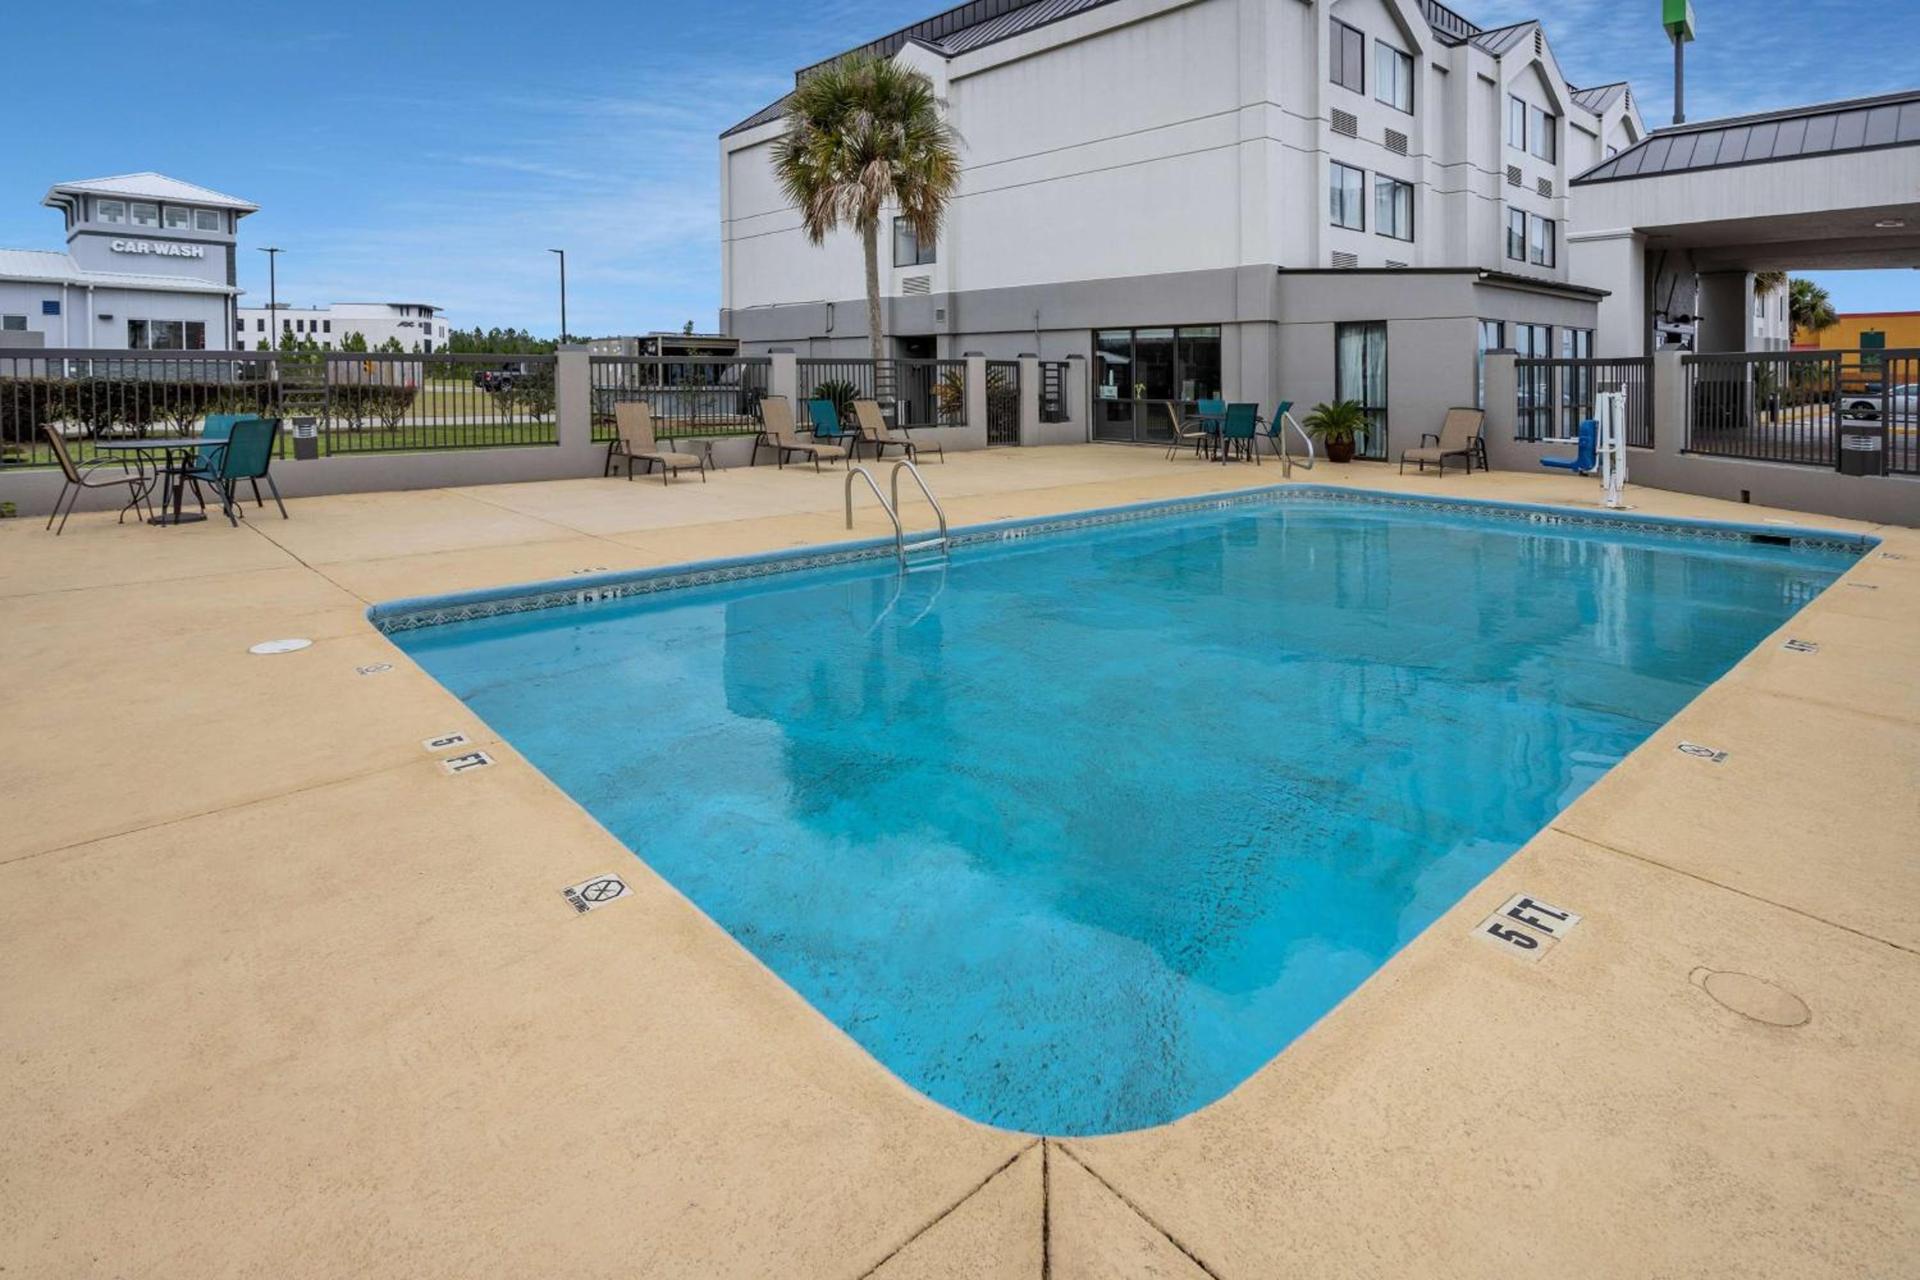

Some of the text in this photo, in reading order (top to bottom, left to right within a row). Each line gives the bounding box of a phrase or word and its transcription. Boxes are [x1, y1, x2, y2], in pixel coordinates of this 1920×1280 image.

[111, 240, 204, 257] CAR WASH
[431, 735, 464, 747] 5
[1487, 922, 1538, 950] 5
